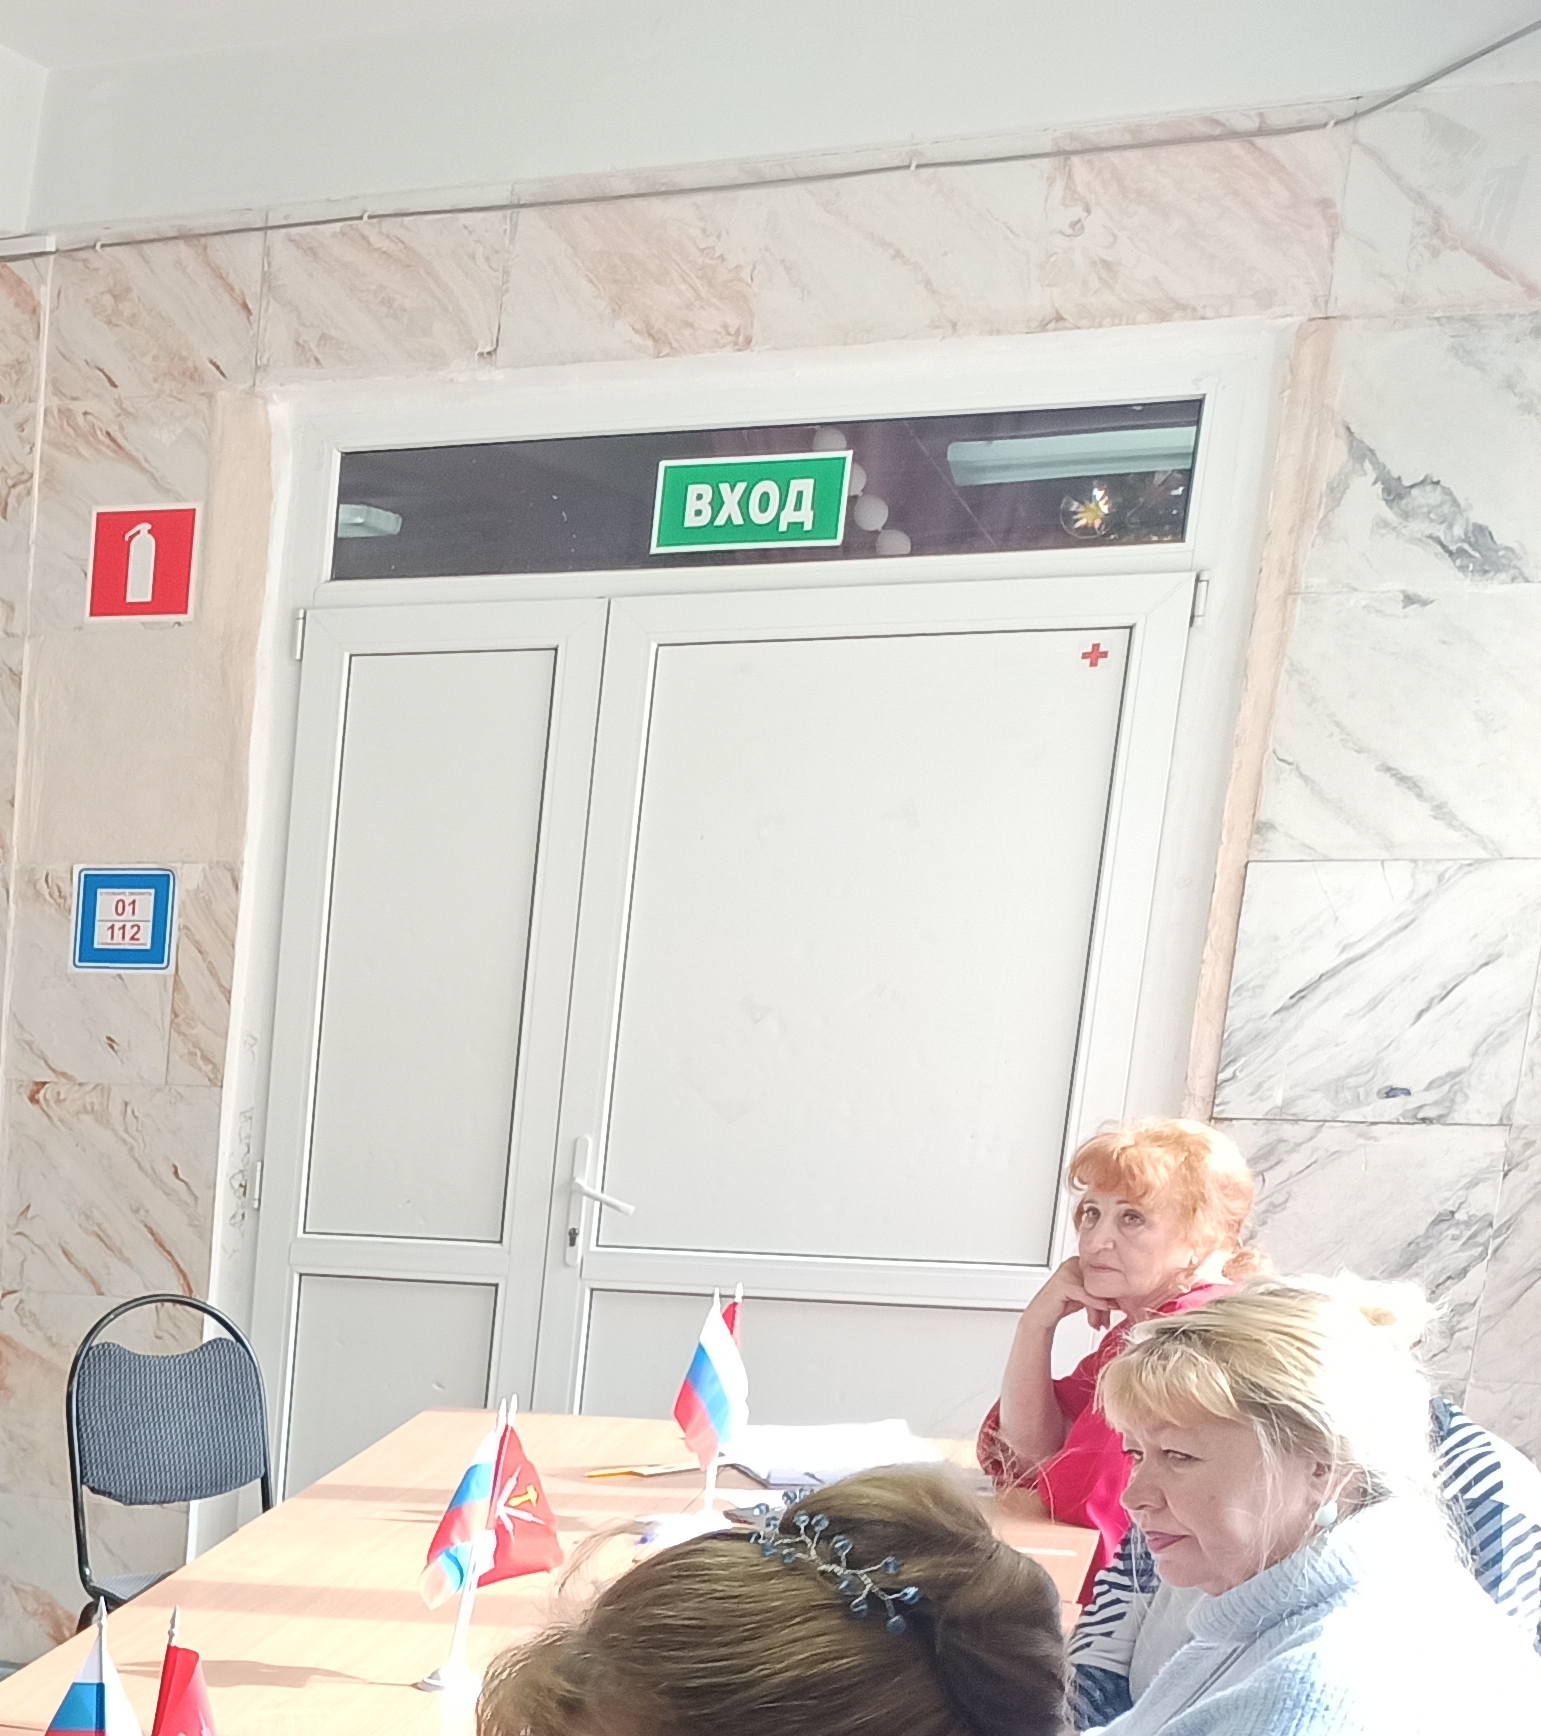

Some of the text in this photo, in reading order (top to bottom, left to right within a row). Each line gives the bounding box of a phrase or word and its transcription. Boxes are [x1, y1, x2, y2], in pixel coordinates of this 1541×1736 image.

[683, 478, 816, 532] ВХОД
[114, 898, 137, 917] 01
[106, 923, 141, 942] 112
